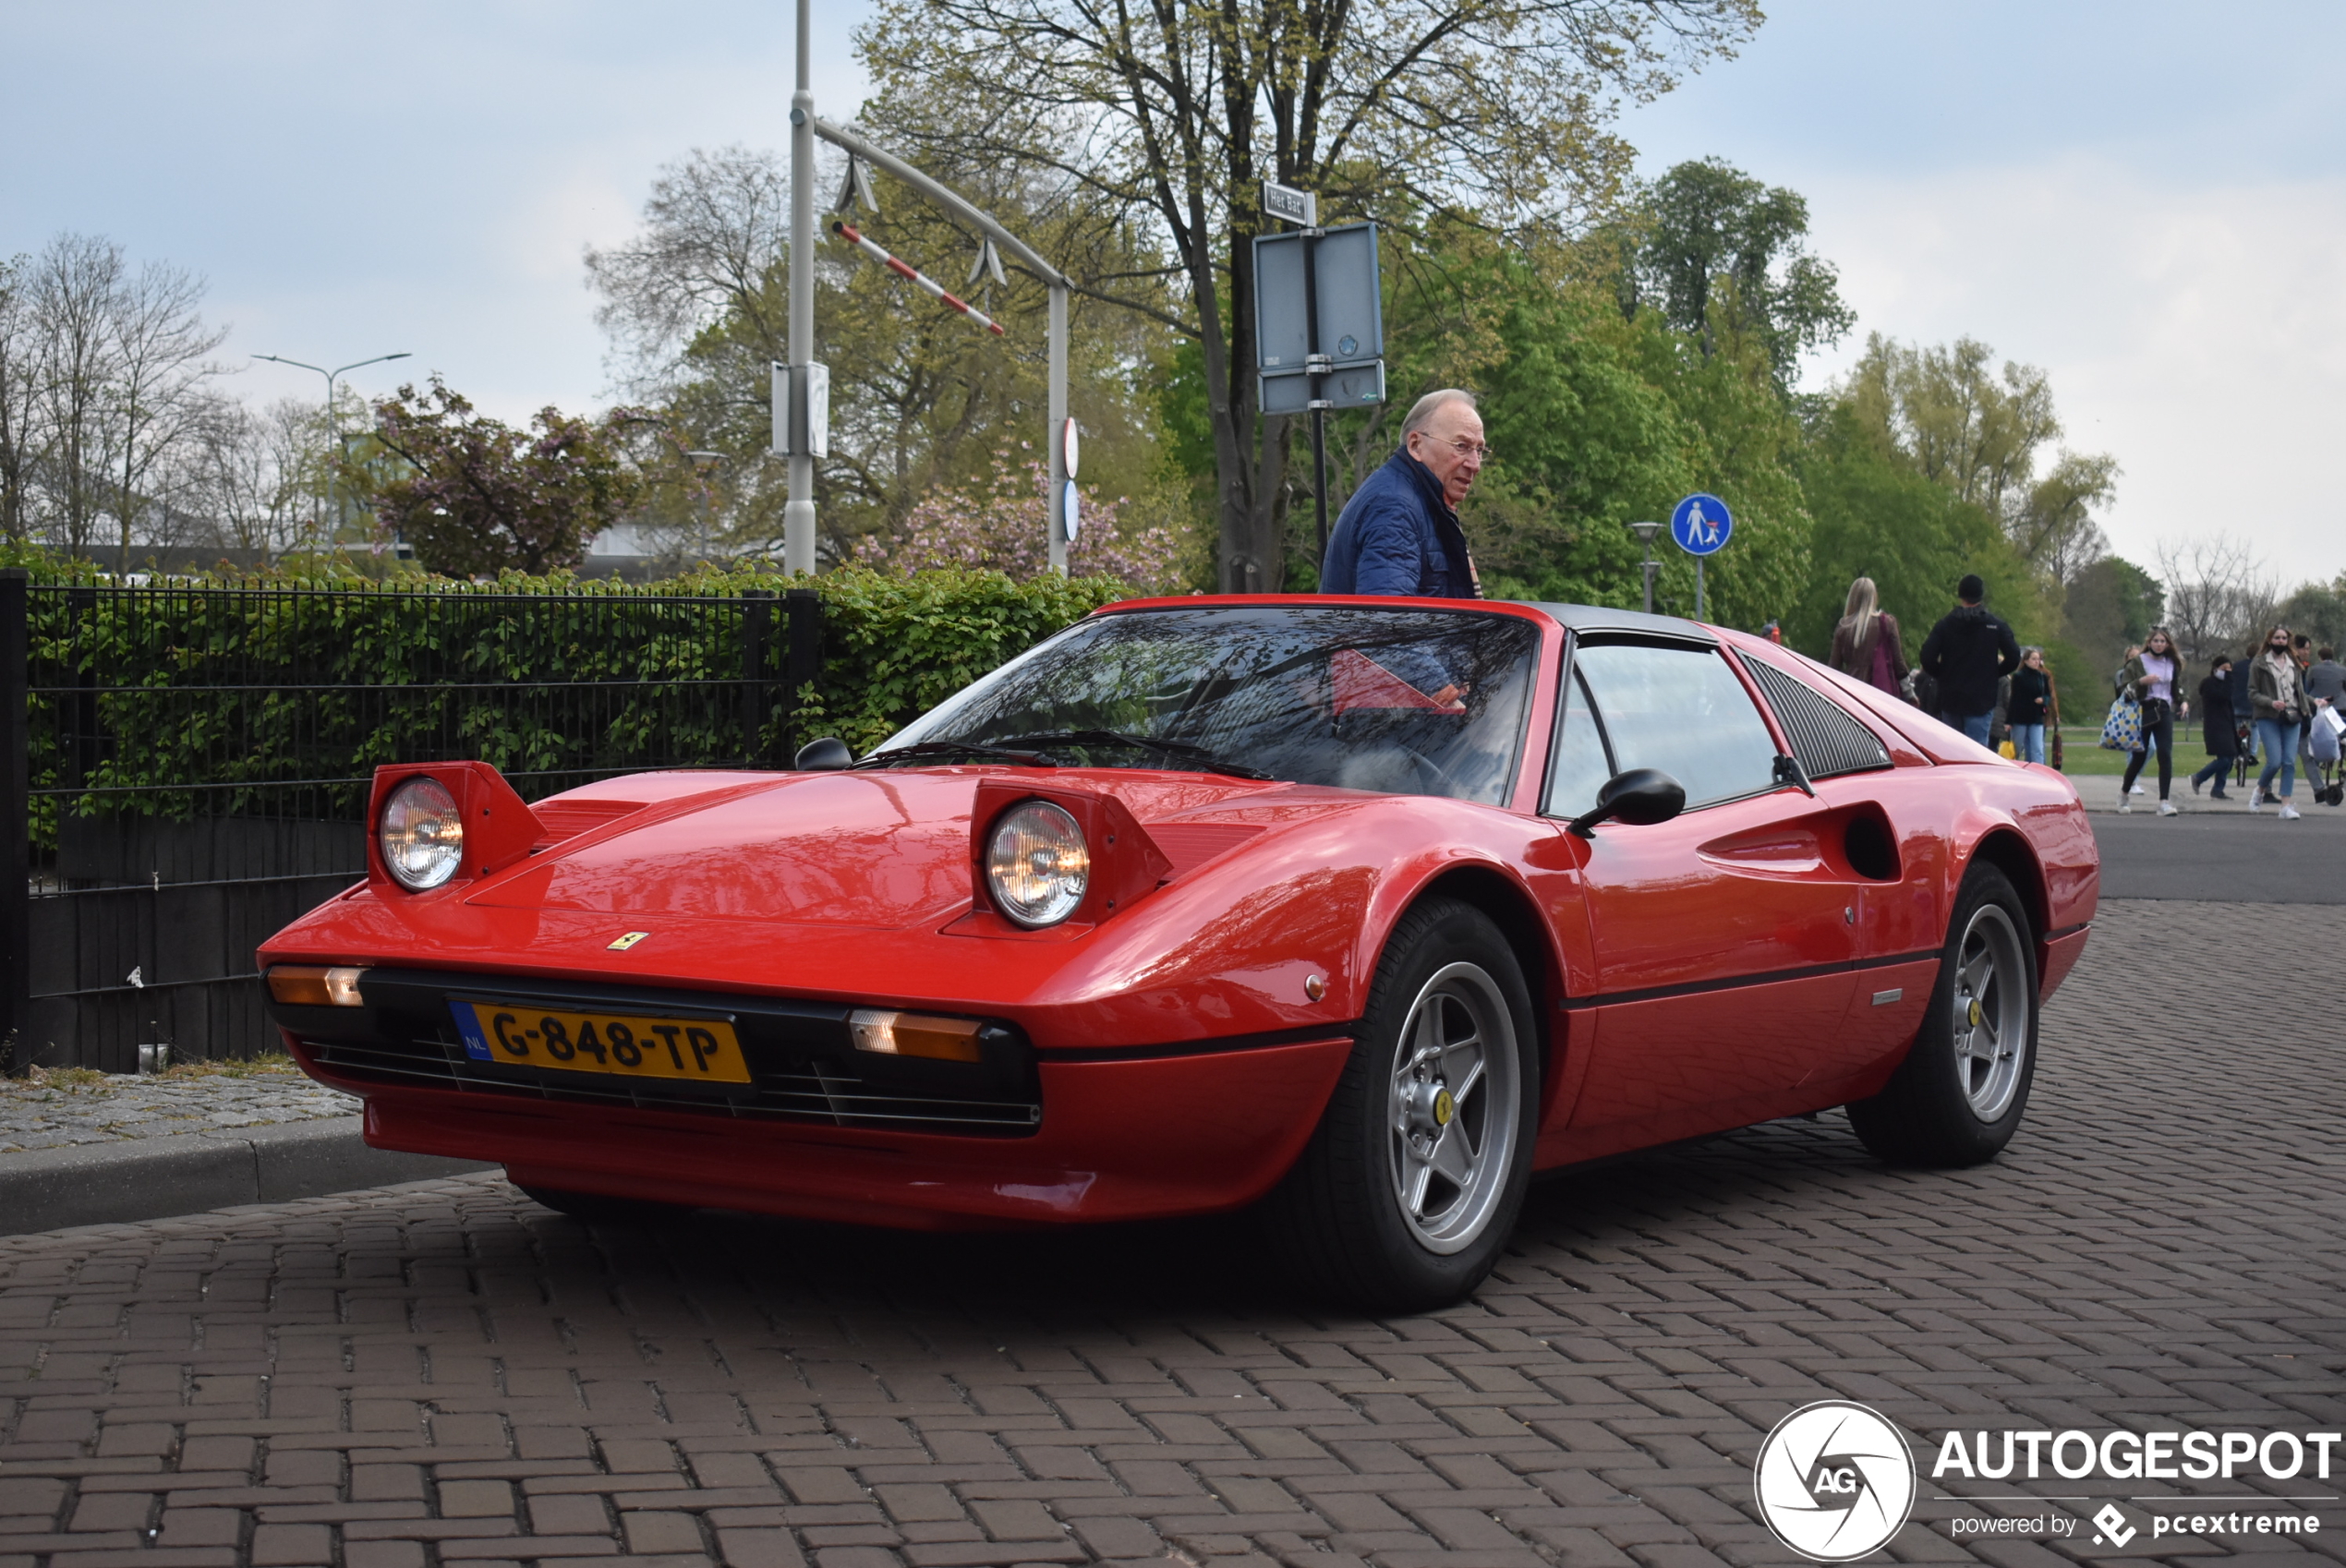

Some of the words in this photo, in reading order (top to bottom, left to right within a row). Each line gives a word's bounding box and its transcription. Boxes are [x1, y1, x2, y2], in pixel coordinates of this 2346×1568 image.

[1270, 189, 1285, 209] Het
[1287, 195, 1300, 214] Bat
[465, 1035, 487, 1051] NL
[493, 1012, 718, 1071] G-848-TP
